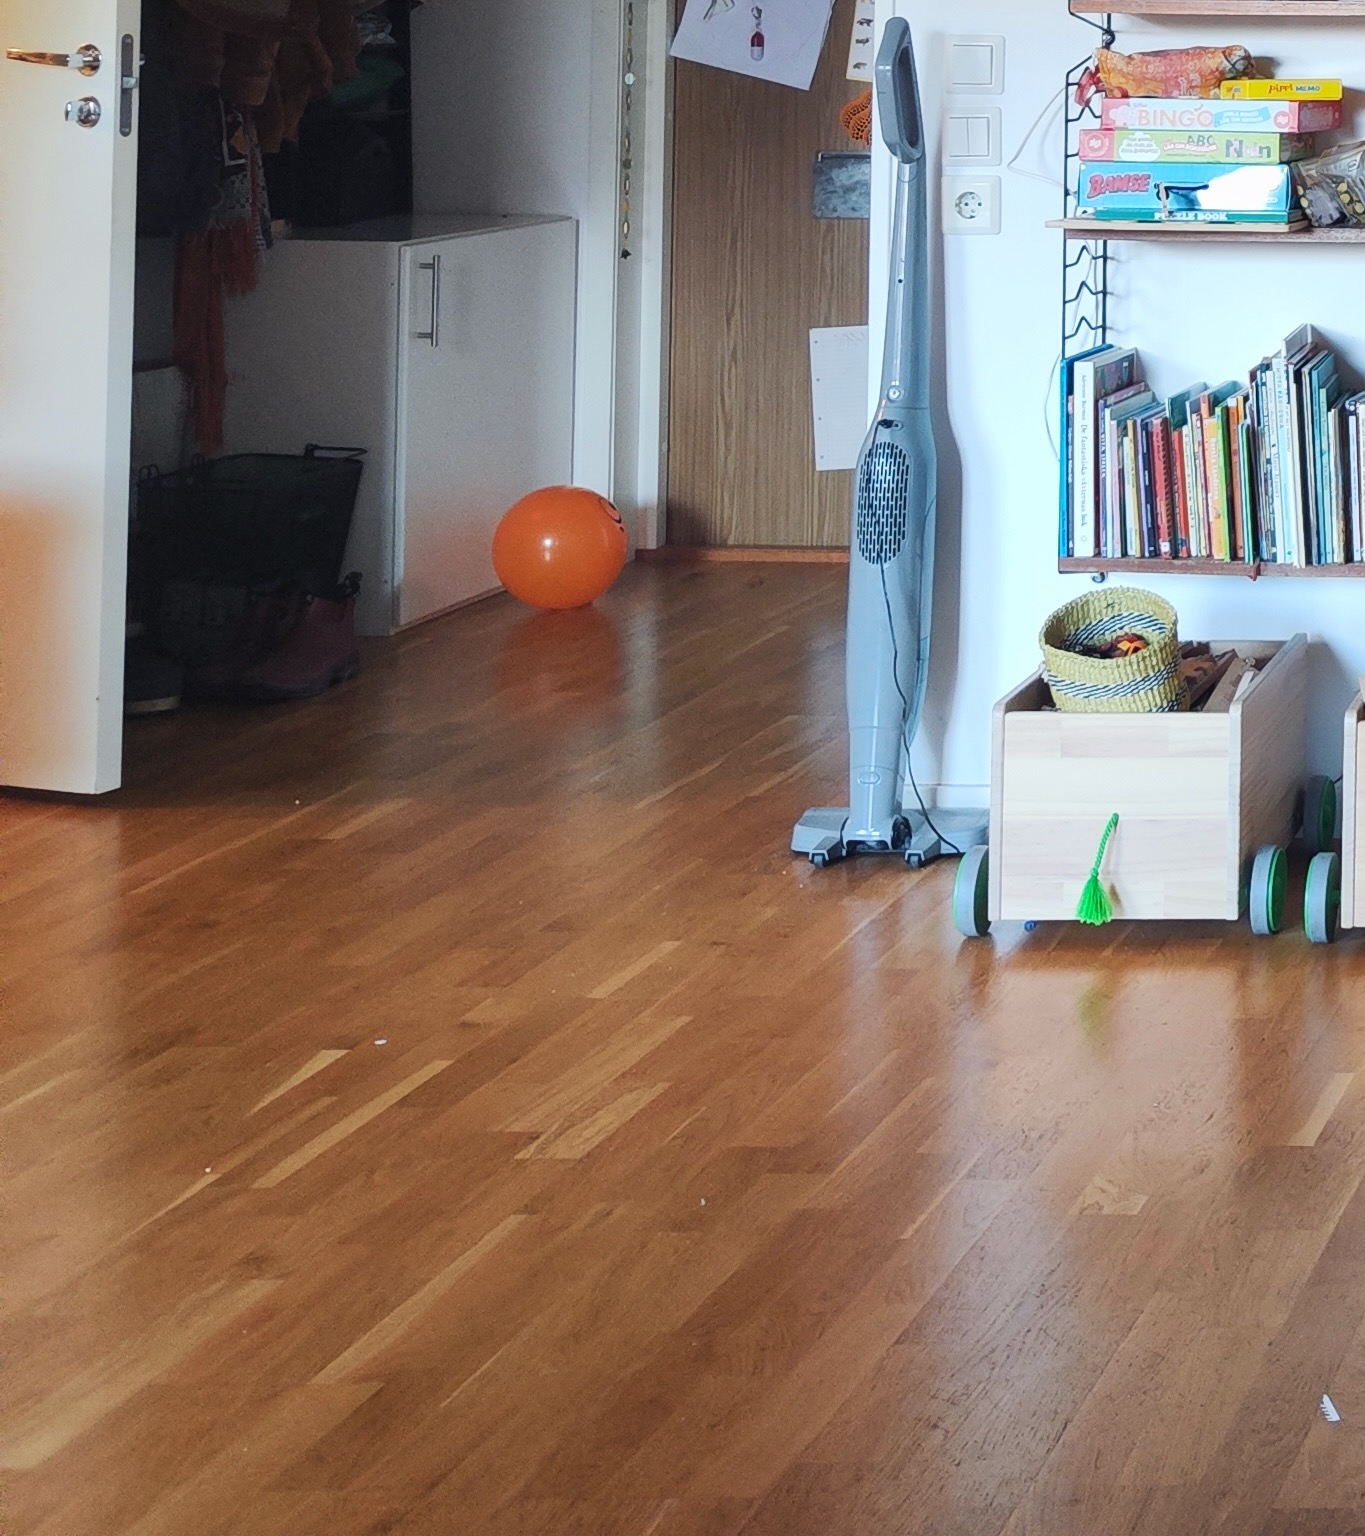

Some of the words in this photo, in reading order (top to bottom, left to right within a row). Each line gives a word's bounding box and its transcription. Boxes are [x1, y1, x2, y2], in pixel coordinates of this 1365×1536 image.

[1137, 109, 1214, 128] BINGO
[1186, 134, 1214, 146] ABC
[1086, 173, 1151, 199] BAMSE
